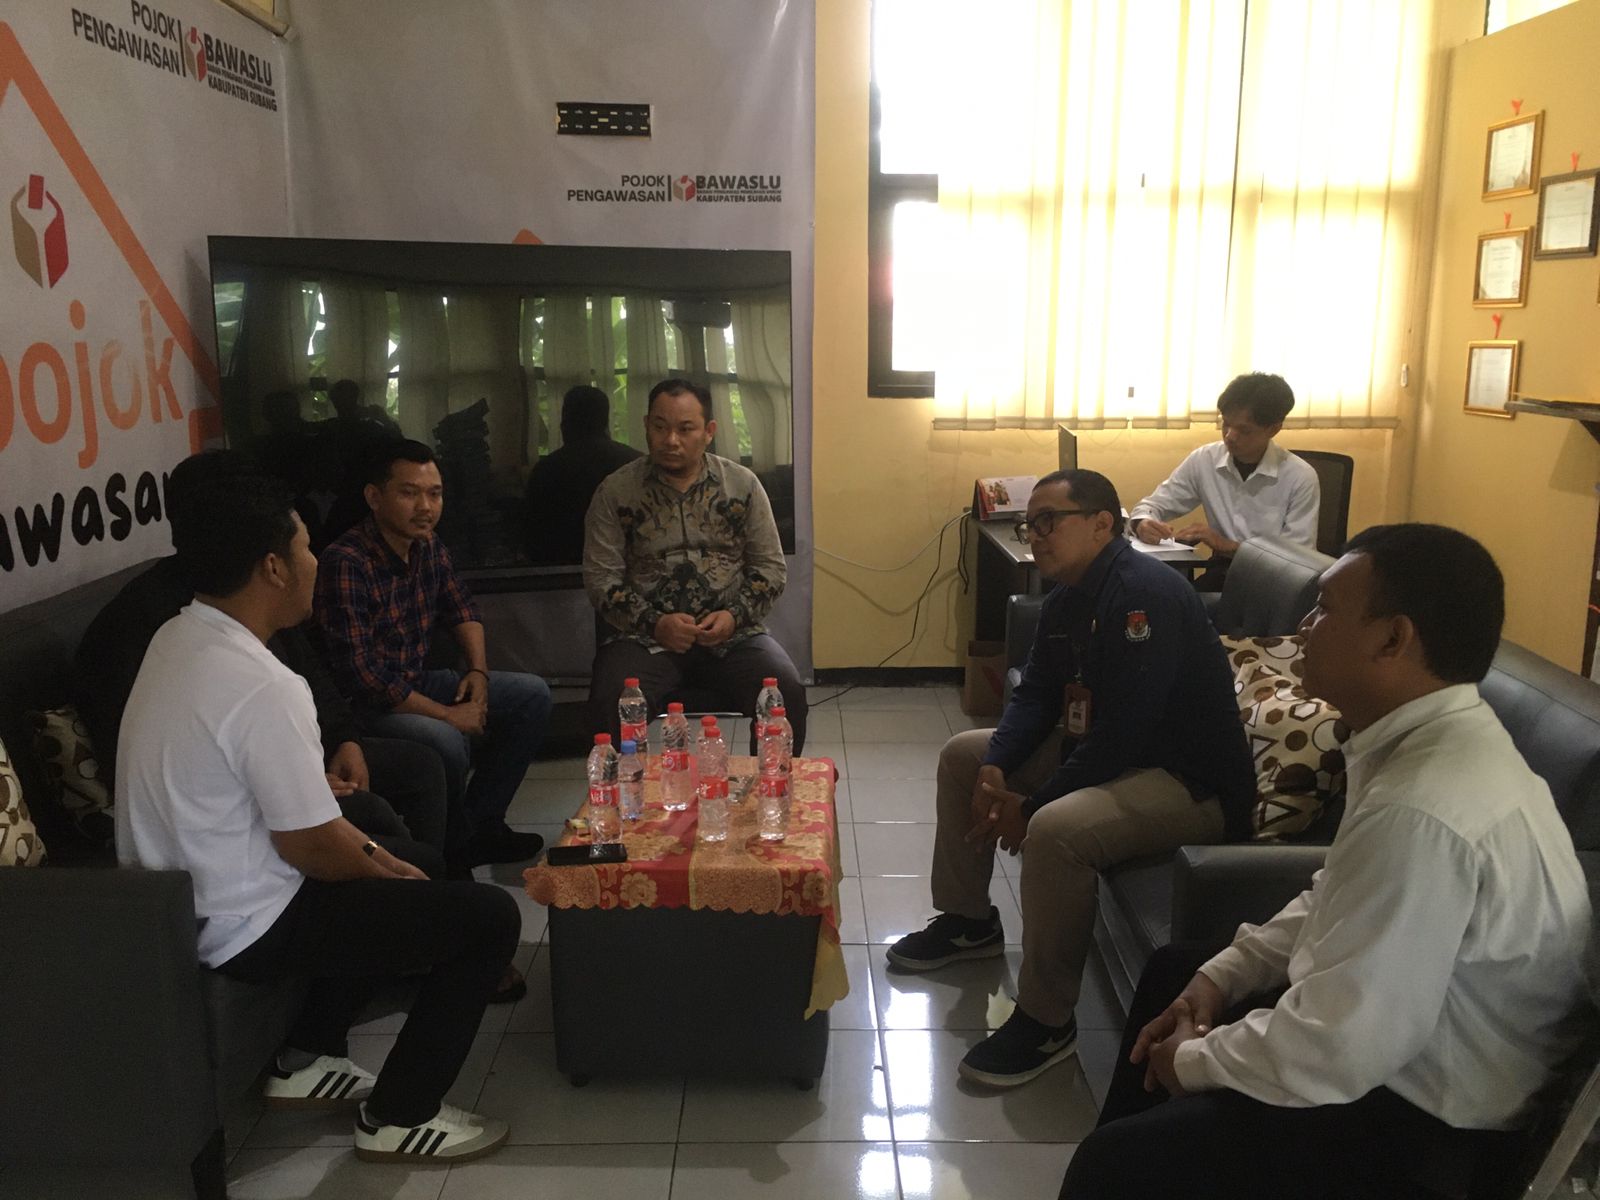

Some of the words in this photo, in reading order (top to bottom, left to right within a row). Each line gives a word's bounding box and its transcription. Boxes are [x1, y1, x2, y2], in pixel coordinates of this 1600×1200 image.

[131, 0, 177, 42] POJOK
[71, 8, 180, 76] PENGAWASAN
[204, 33, 272, 87] BAWASLU
[208, 74, 249, 102] KABUPATEN
[250, 91, 277, 111] SUBANG
[567, 189, 665, 202] PENGAWASAN
[621, 175, 665, 187] POJOK
[696, 175, 781, 189] BAWASLU
[696, 194, 745, 202] KABUPATEN
[747, 194, 781, 202] SUBANG
[0, 470, 168, 572] wasa
